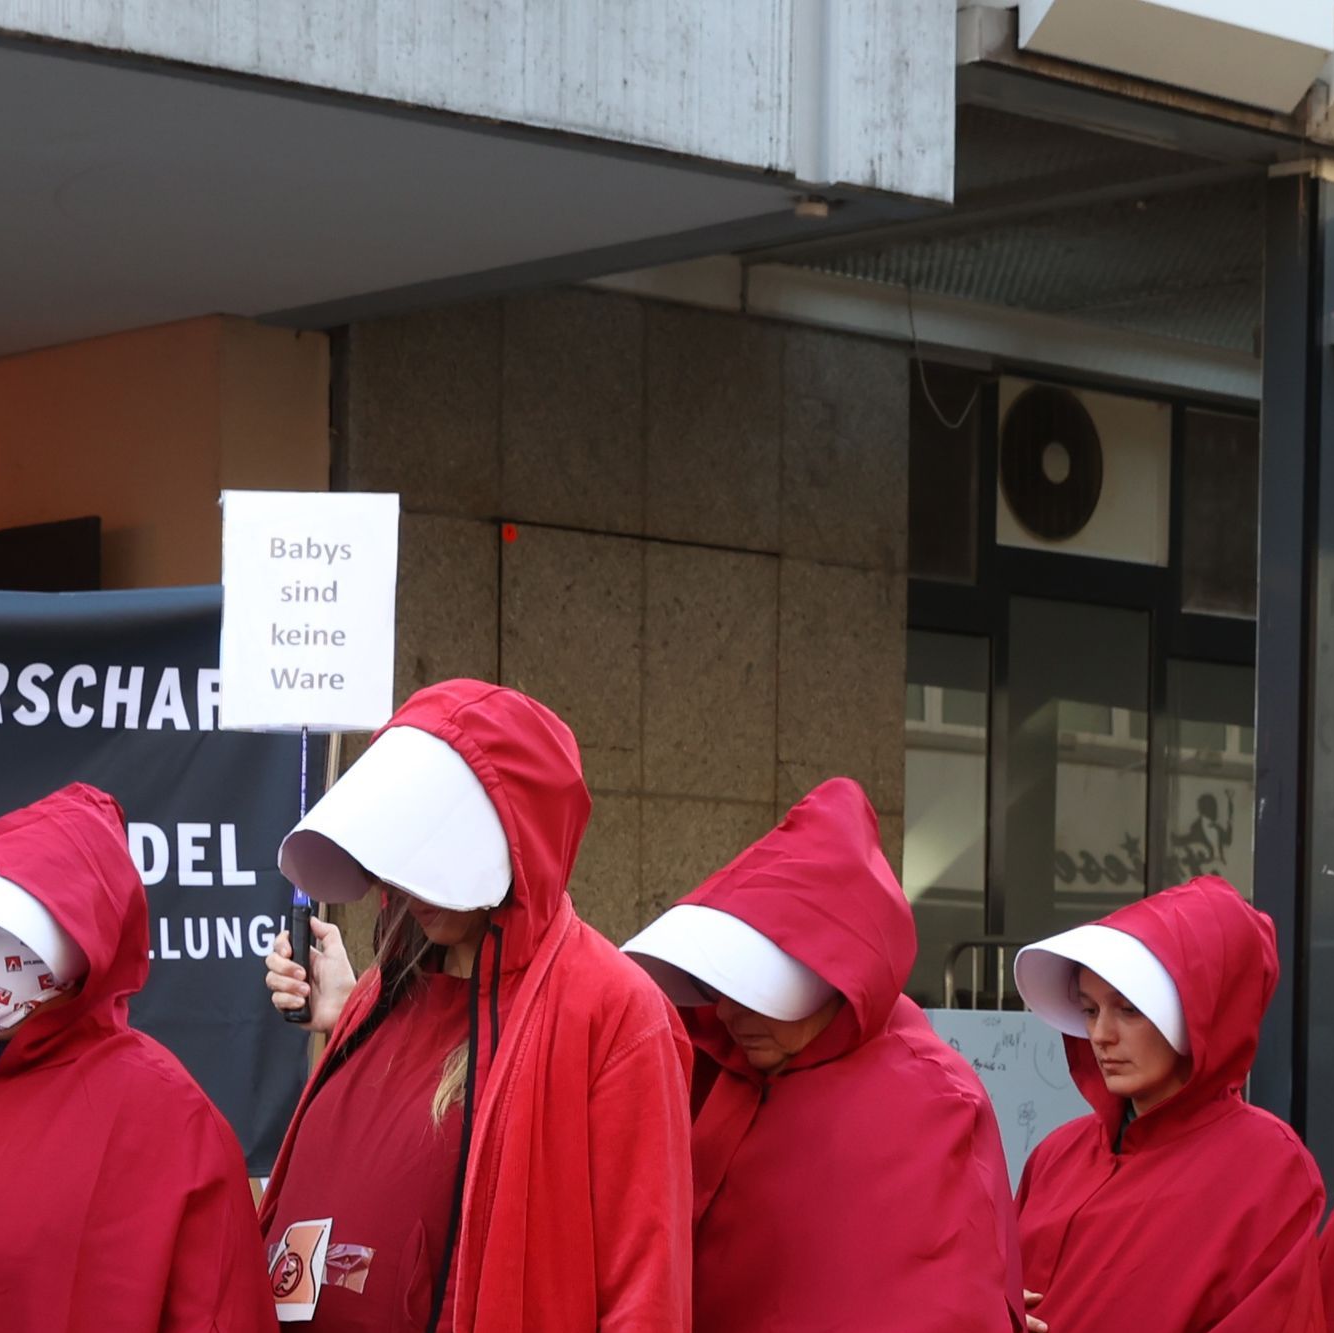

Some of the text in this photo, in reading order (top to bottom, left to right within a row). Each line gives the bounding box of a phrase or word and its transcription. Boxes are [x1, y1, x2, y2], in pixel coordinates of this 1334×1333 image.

[270, 537, 352, 565] Babys
[280, 580, 337, 603] sind
[271, 623, 346, 646] keine
[271, 668, 344, 690] Ware
